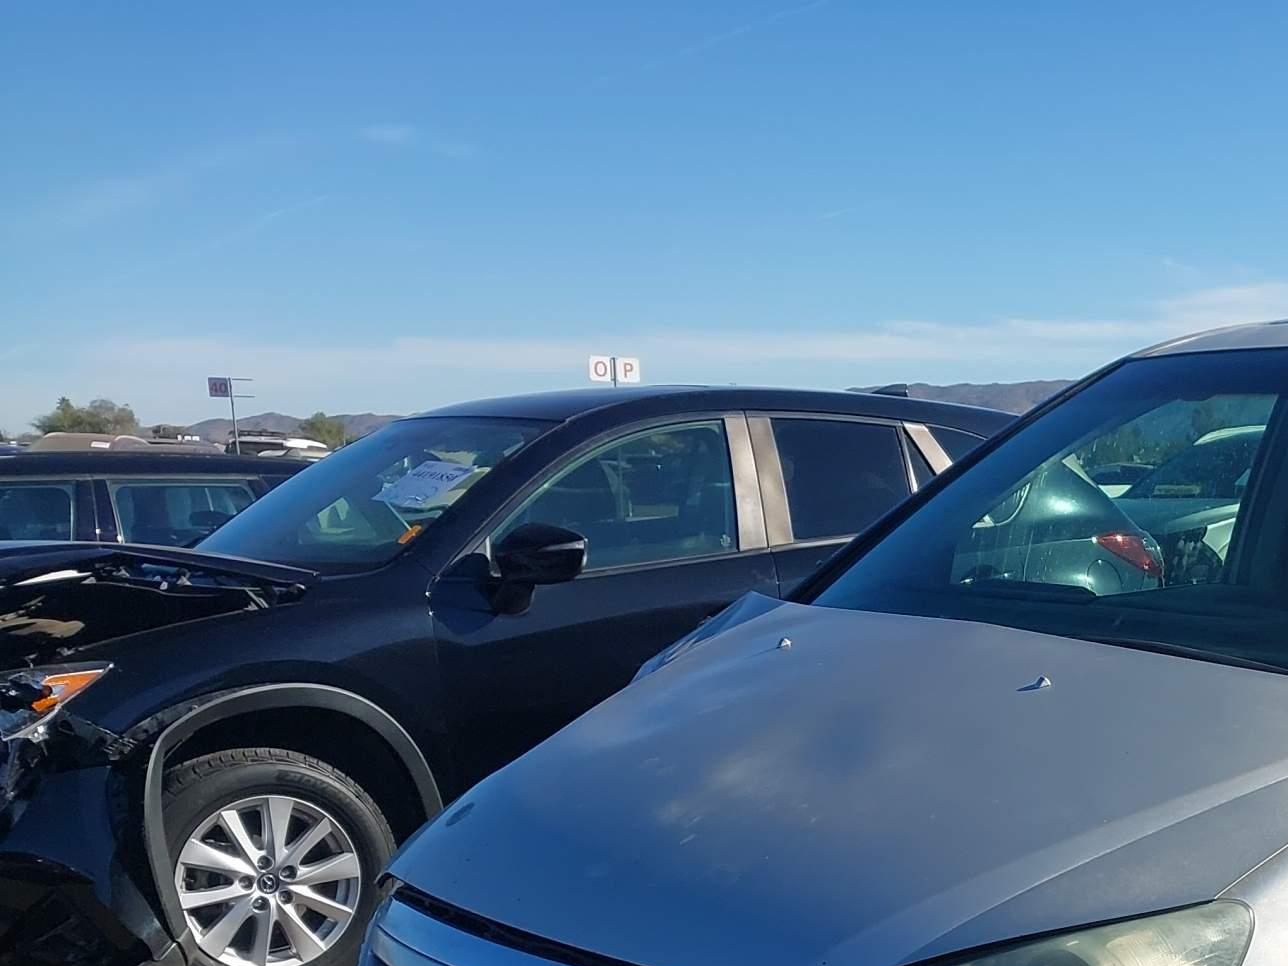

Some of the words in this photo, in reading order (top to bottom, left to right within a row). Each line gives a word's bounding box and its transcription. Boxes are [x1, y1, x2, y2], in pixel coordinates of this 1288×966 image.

[594, 360, 608, 378] O
[623, 362, 634, 379] P
[210, 381, 228, 395] 40
